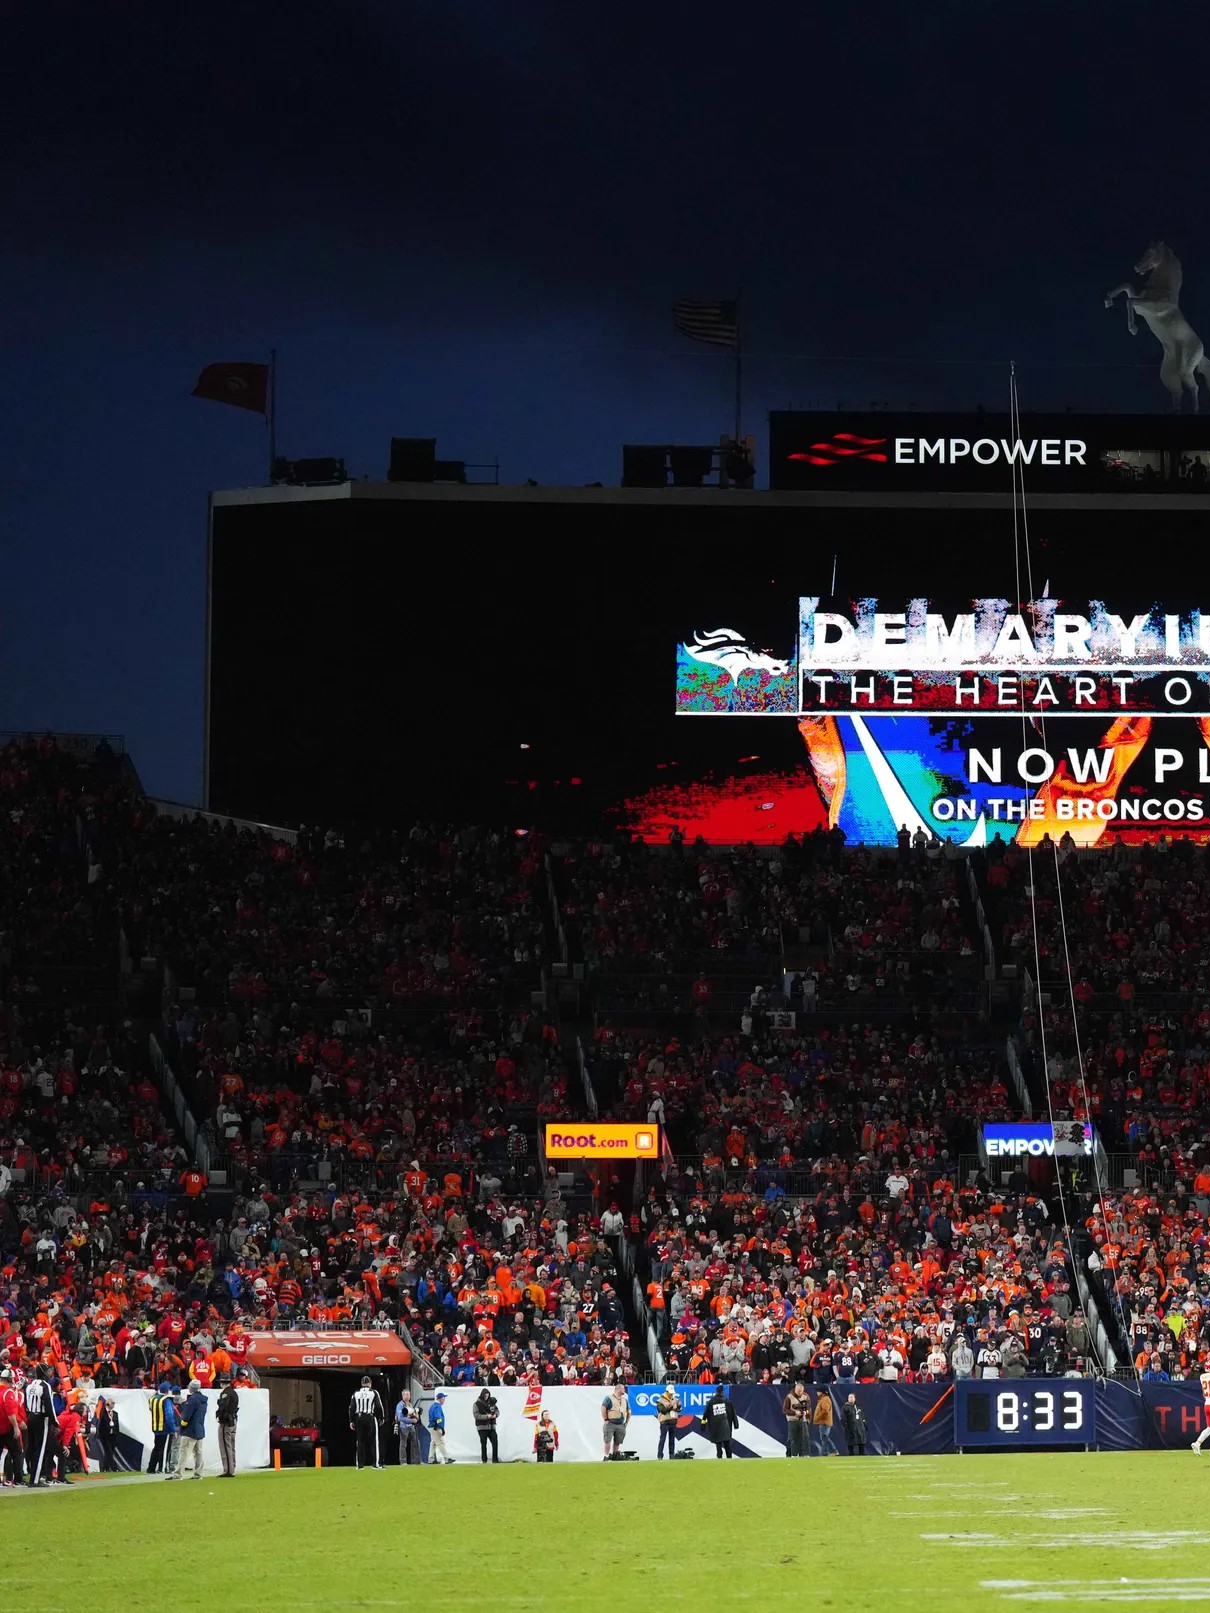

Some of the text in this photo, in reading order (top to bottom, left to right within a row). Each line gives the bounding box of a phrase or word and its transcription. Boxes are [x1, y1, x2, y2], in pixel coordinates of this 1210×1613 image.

[895, 438, 1087, 465] EMPOWER
[813, 676, 913, 705] THE
[955, 676, 1134, 705] HEART
[969, 747, 1116, 783] NOW
[933, 798, 977, 821] ON
[991, 798, 1045, 821] THE
[1057, 798, 1204, 821] BRONCOS
[551, 1133, 628, 1148] Root.com
[582, 1304, 593, 1313] 27
[1029, 1327, 1042, 1338] 30
[1136, 1325, 1147, 1335] 88
[235, 1340, 245, 1352] 15
[302, 1355, 350, 1364] GEICO
[842, 1356, 852, 1366] 88
[997, 1392, 1083, 1431] 8:33
